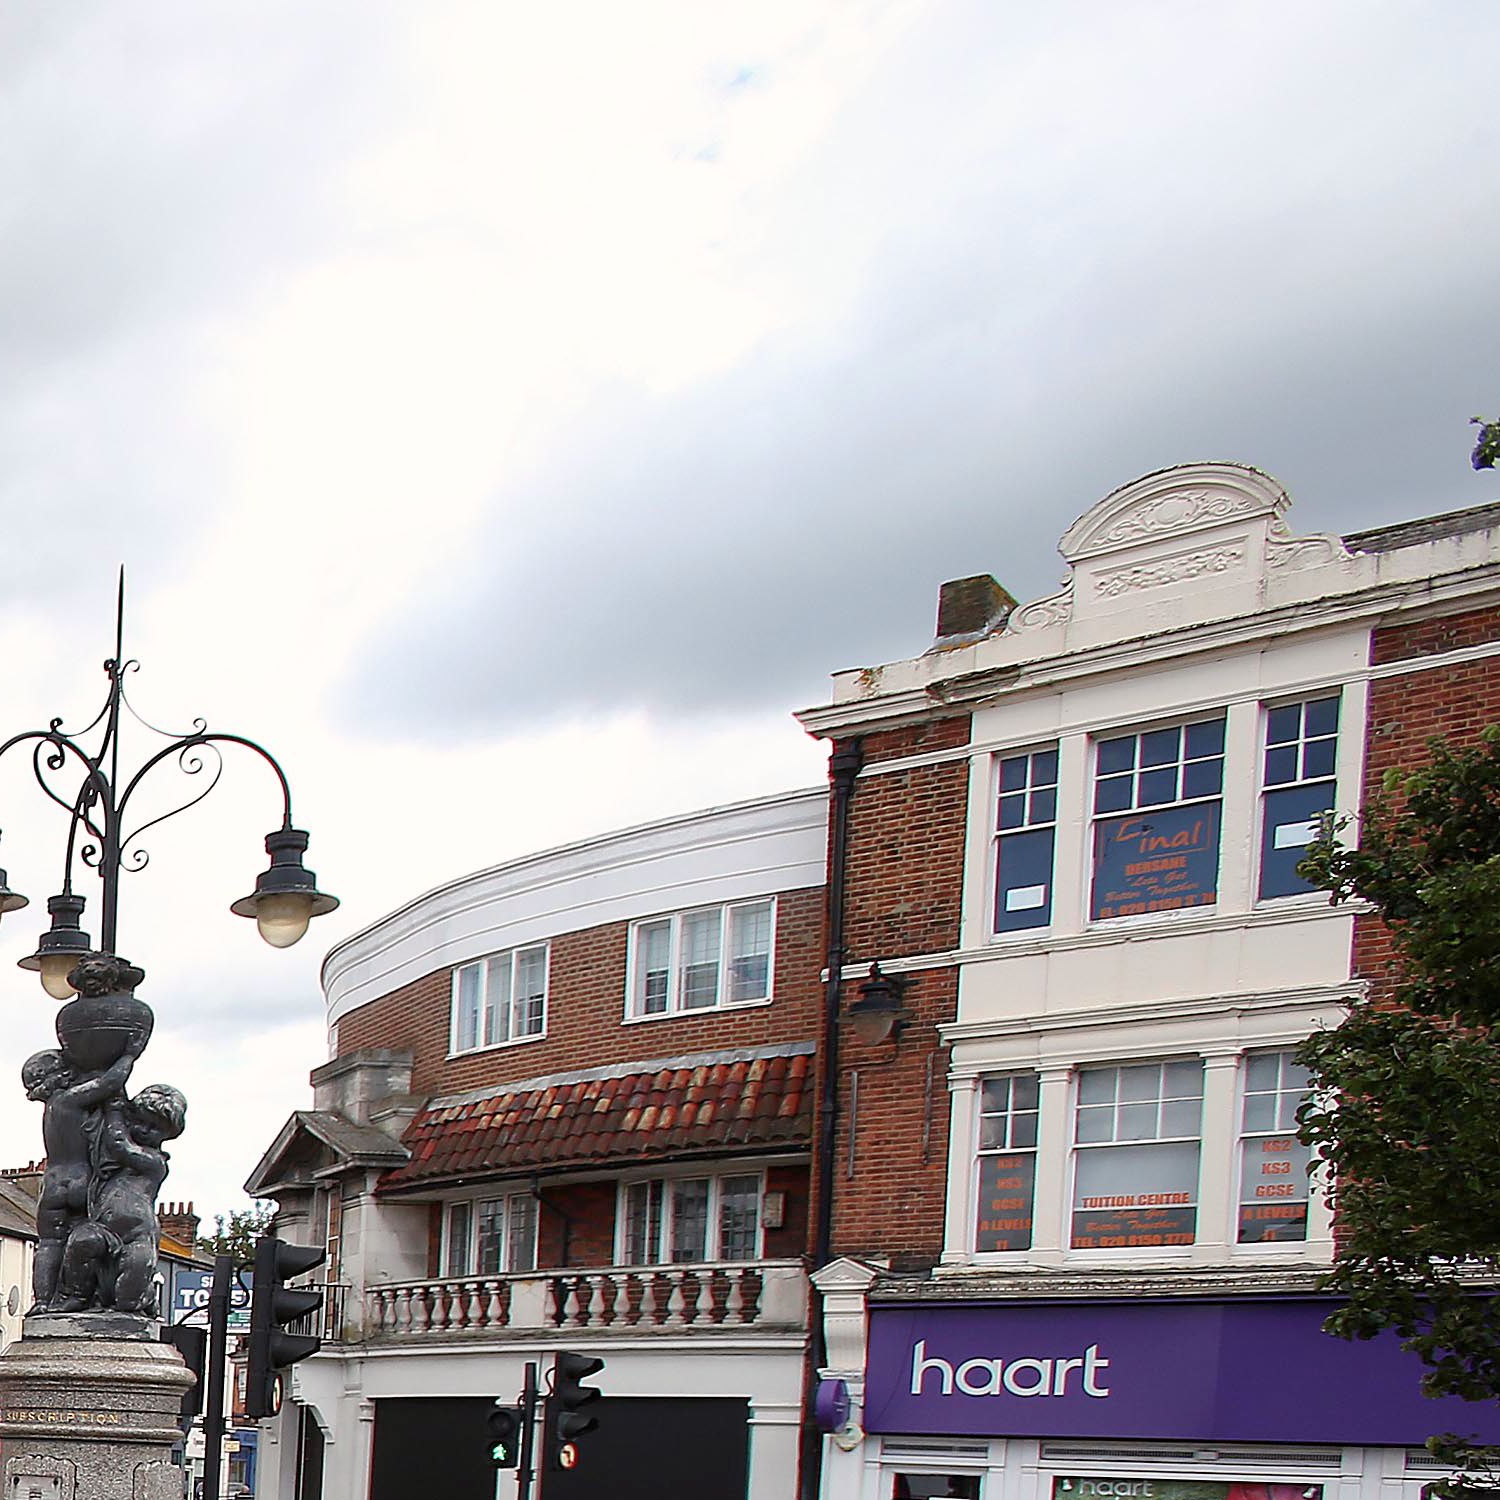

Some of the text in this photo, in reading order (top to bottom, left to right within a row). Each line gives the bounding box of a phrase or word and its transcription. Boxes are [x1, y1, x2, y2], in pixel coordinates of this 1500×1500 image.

[1262, 1141, 1292, 1153] KS2
[1261, 1162, 1291, 1174] KS3
[1255, 1184, 1295, 1197] GCSE
[1082, 1192, 1190, 1208] TUITION CENTRE
[1256, 1206, 1305, 1219] LEVELS
[910, 1339, 1110, 1397] haart
[6, 1410, 121, 1425] SUBSCRIPTION
[1078, 1479, 1154, 1498] haart
